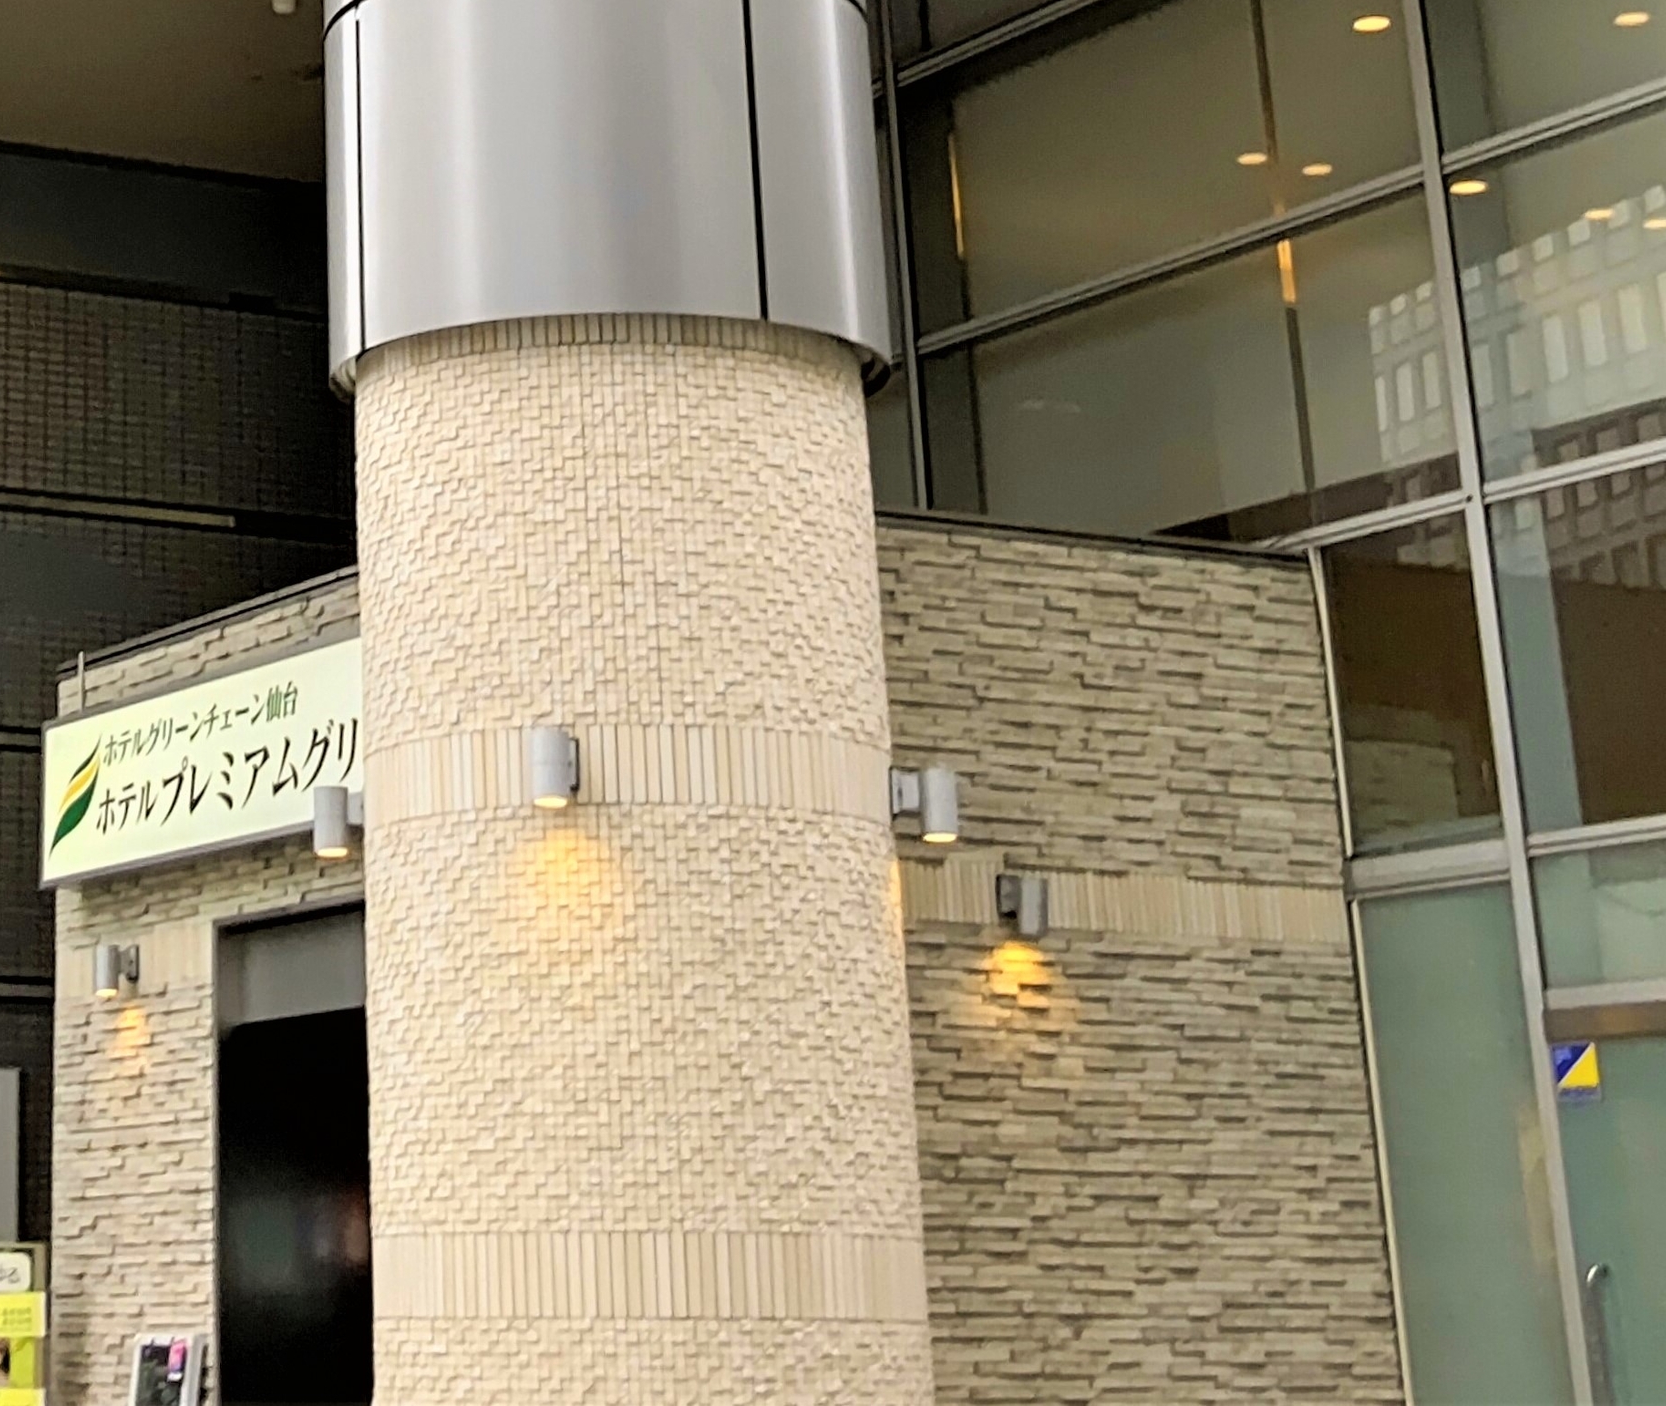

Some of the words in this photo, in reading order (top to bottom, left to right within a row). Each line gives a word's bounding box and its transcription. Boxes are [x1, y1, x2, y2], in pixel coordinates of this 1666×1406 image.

[102, 681, 299, 766] ホテルグリーンチェーン仙台
